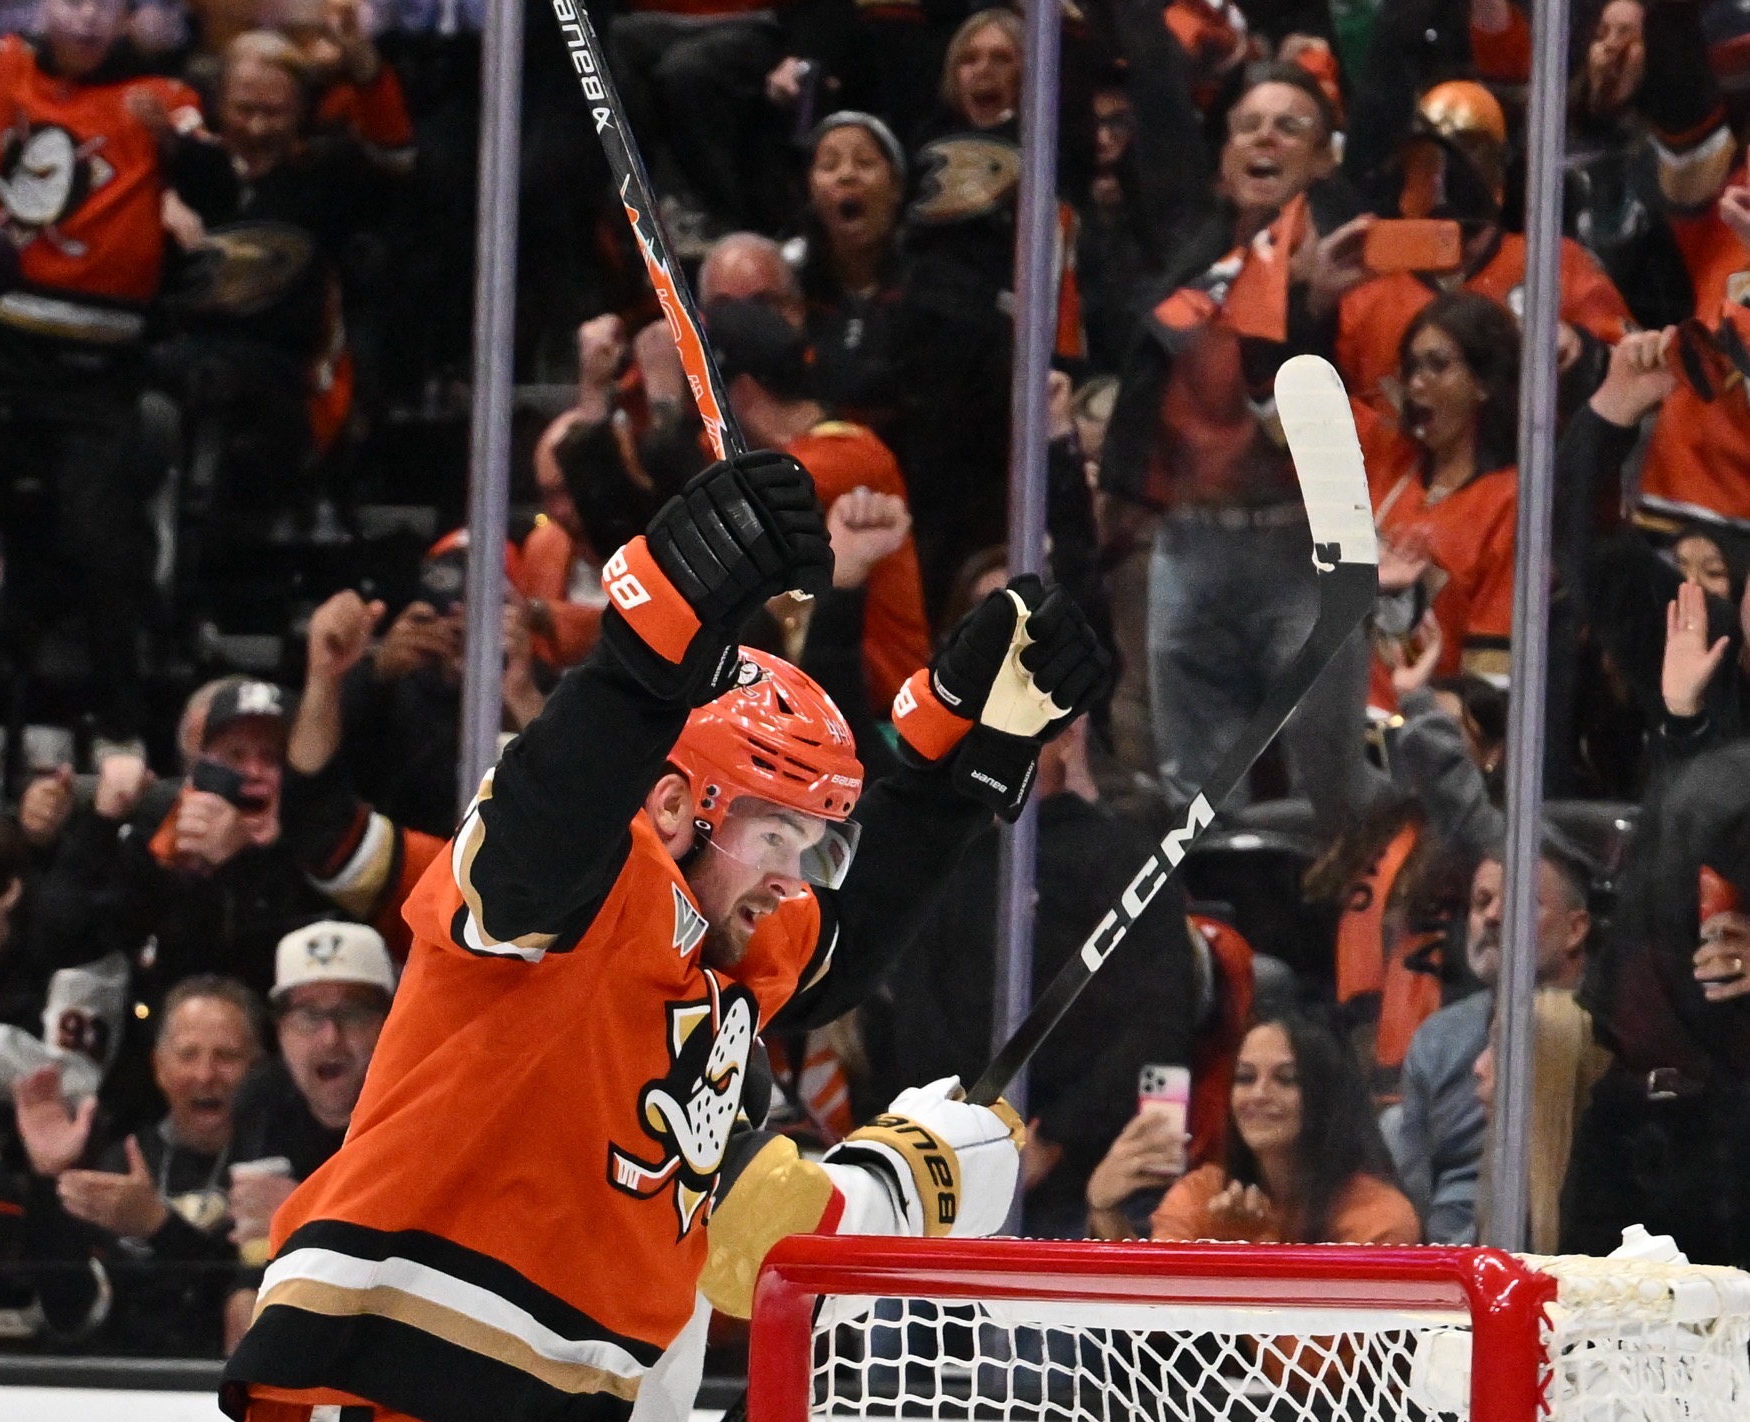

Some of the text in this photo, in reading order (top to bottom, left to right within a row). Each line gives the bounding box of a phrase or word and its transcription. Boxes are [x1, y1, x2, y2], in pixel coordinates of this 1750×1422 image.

[553, 0, 607, 101] BAUE
[602, 545, 652, 610] BA
[830, 774, 861, 788] BAUER
[970, 769, 1008, 793] BAUER
[1080, 791, 1216, 973] CCM
